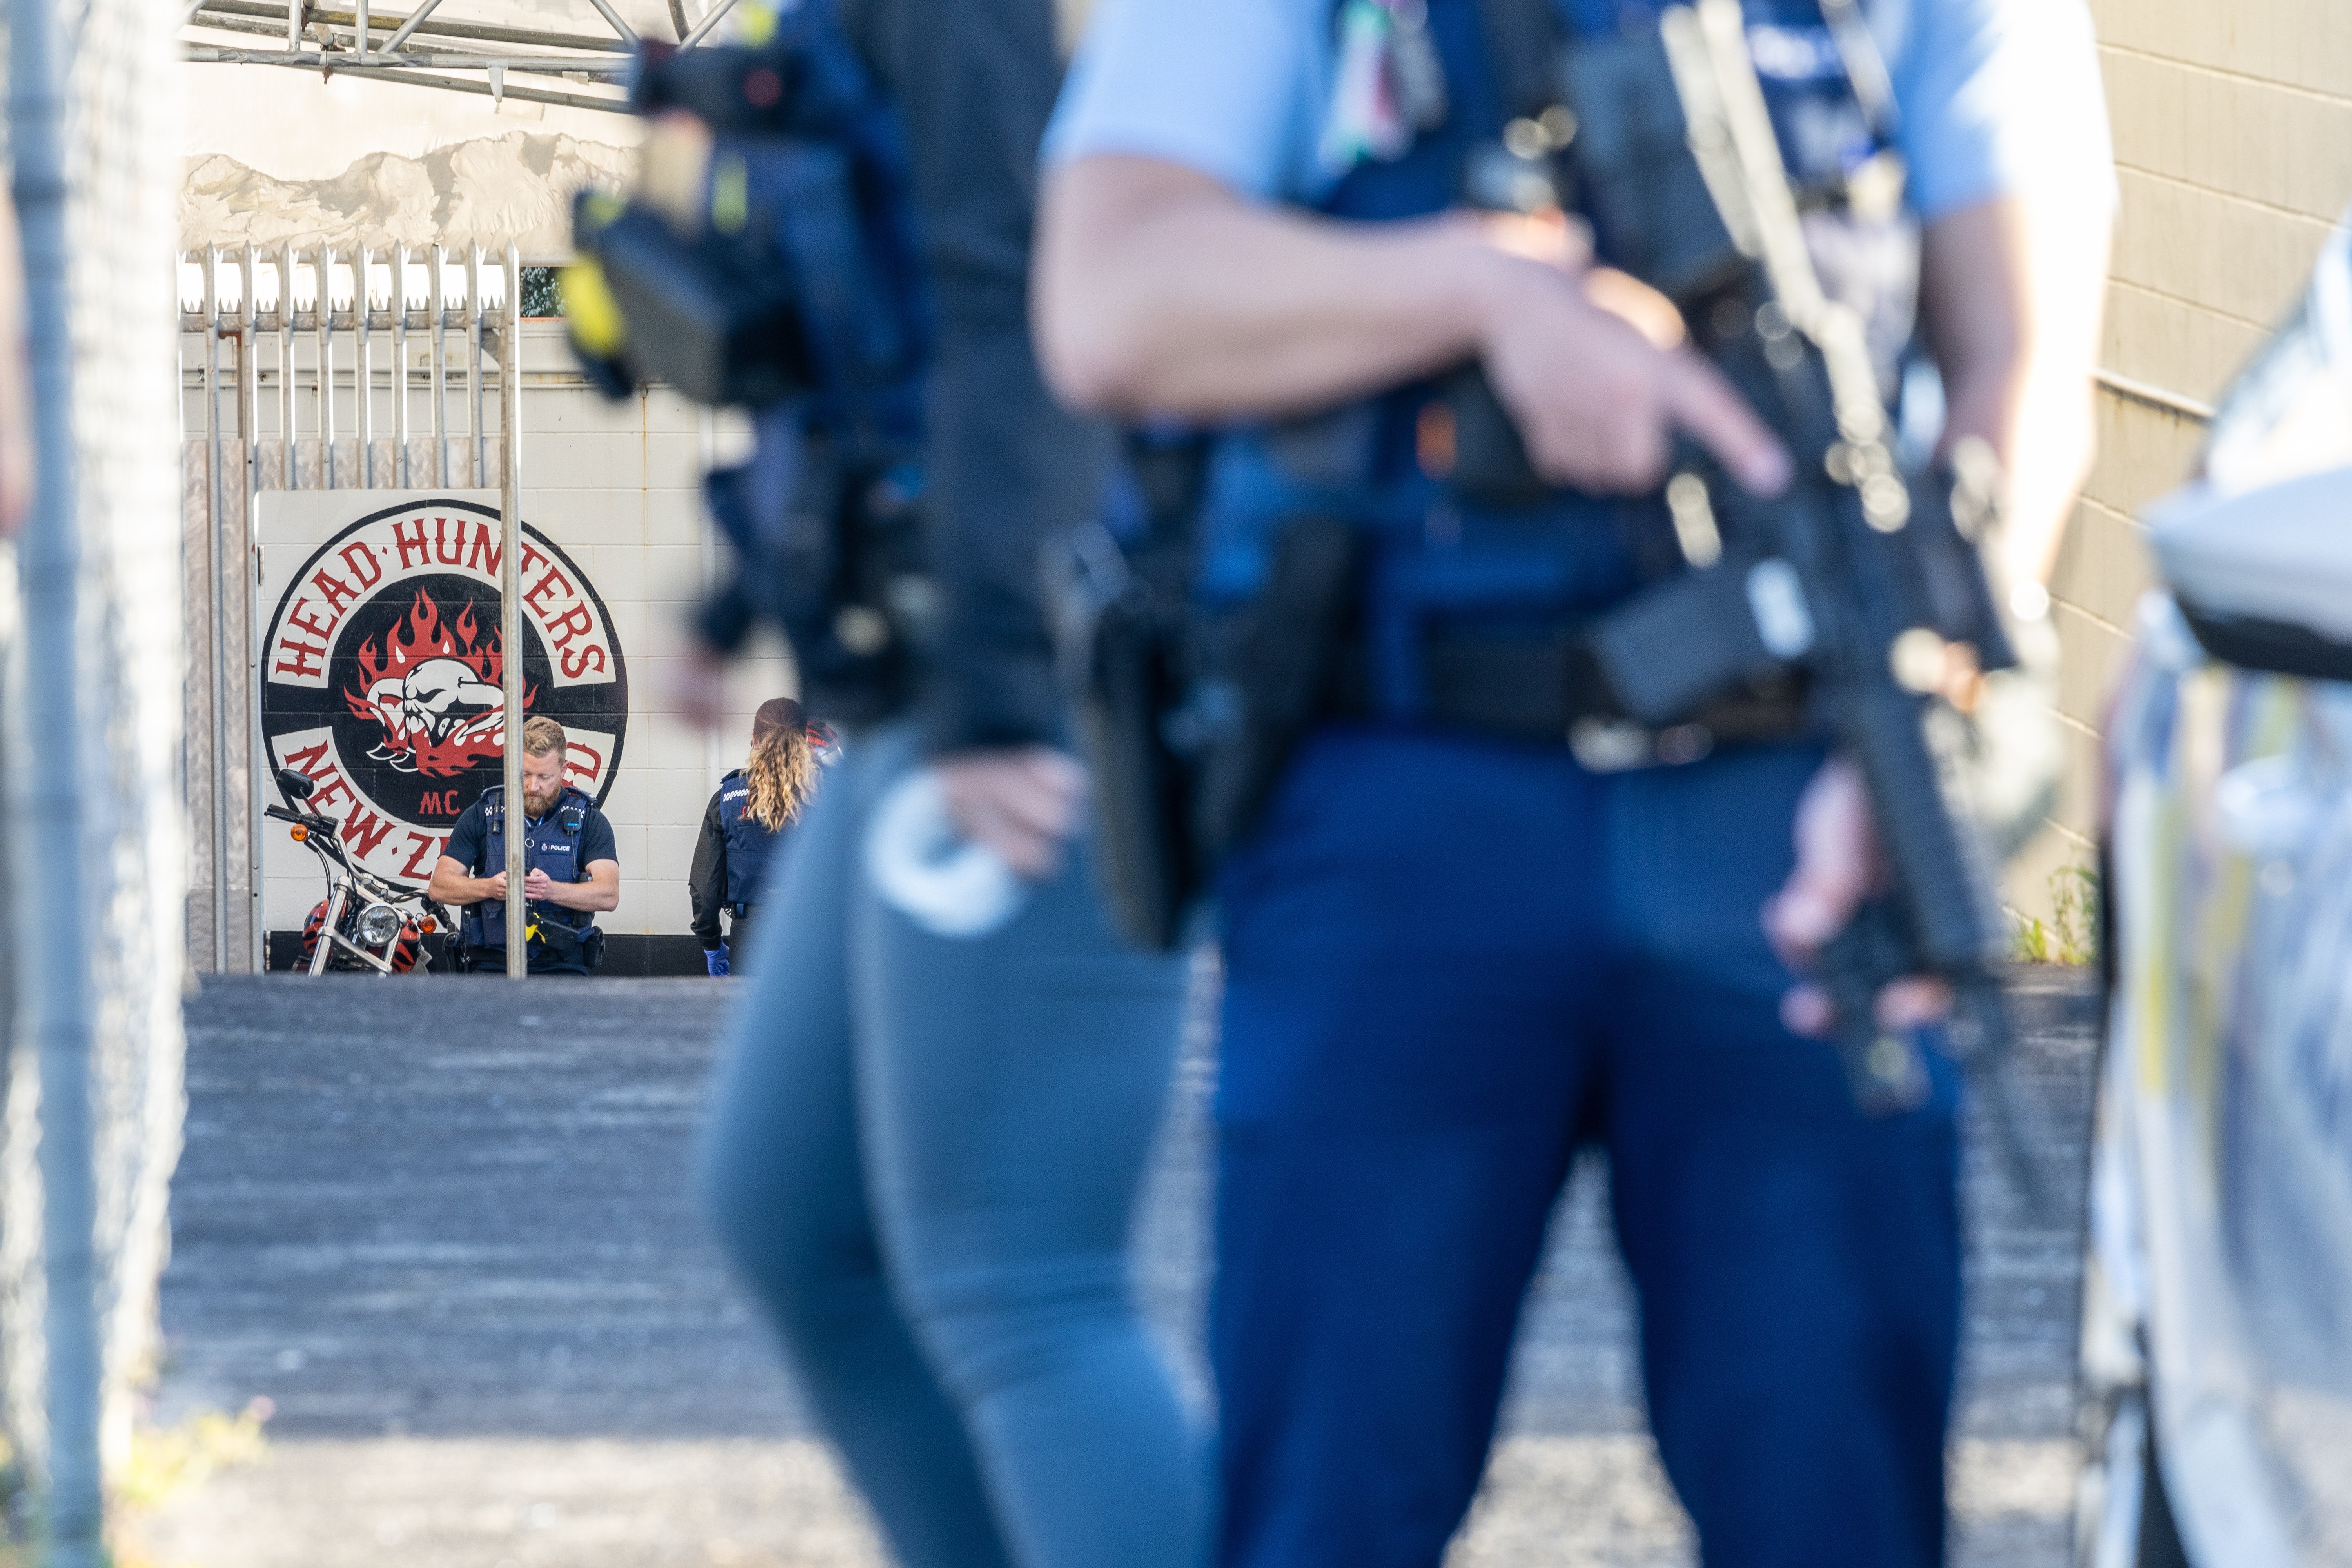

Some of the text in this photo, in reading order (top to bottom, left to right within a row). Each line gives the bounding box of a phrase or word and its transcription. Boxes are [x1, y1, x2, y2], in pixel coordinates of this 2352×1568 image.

[276, 541, 382, 679] HEAD
[284, 739, 397, 861] NEW
[419, 789, 460, 815] MC
